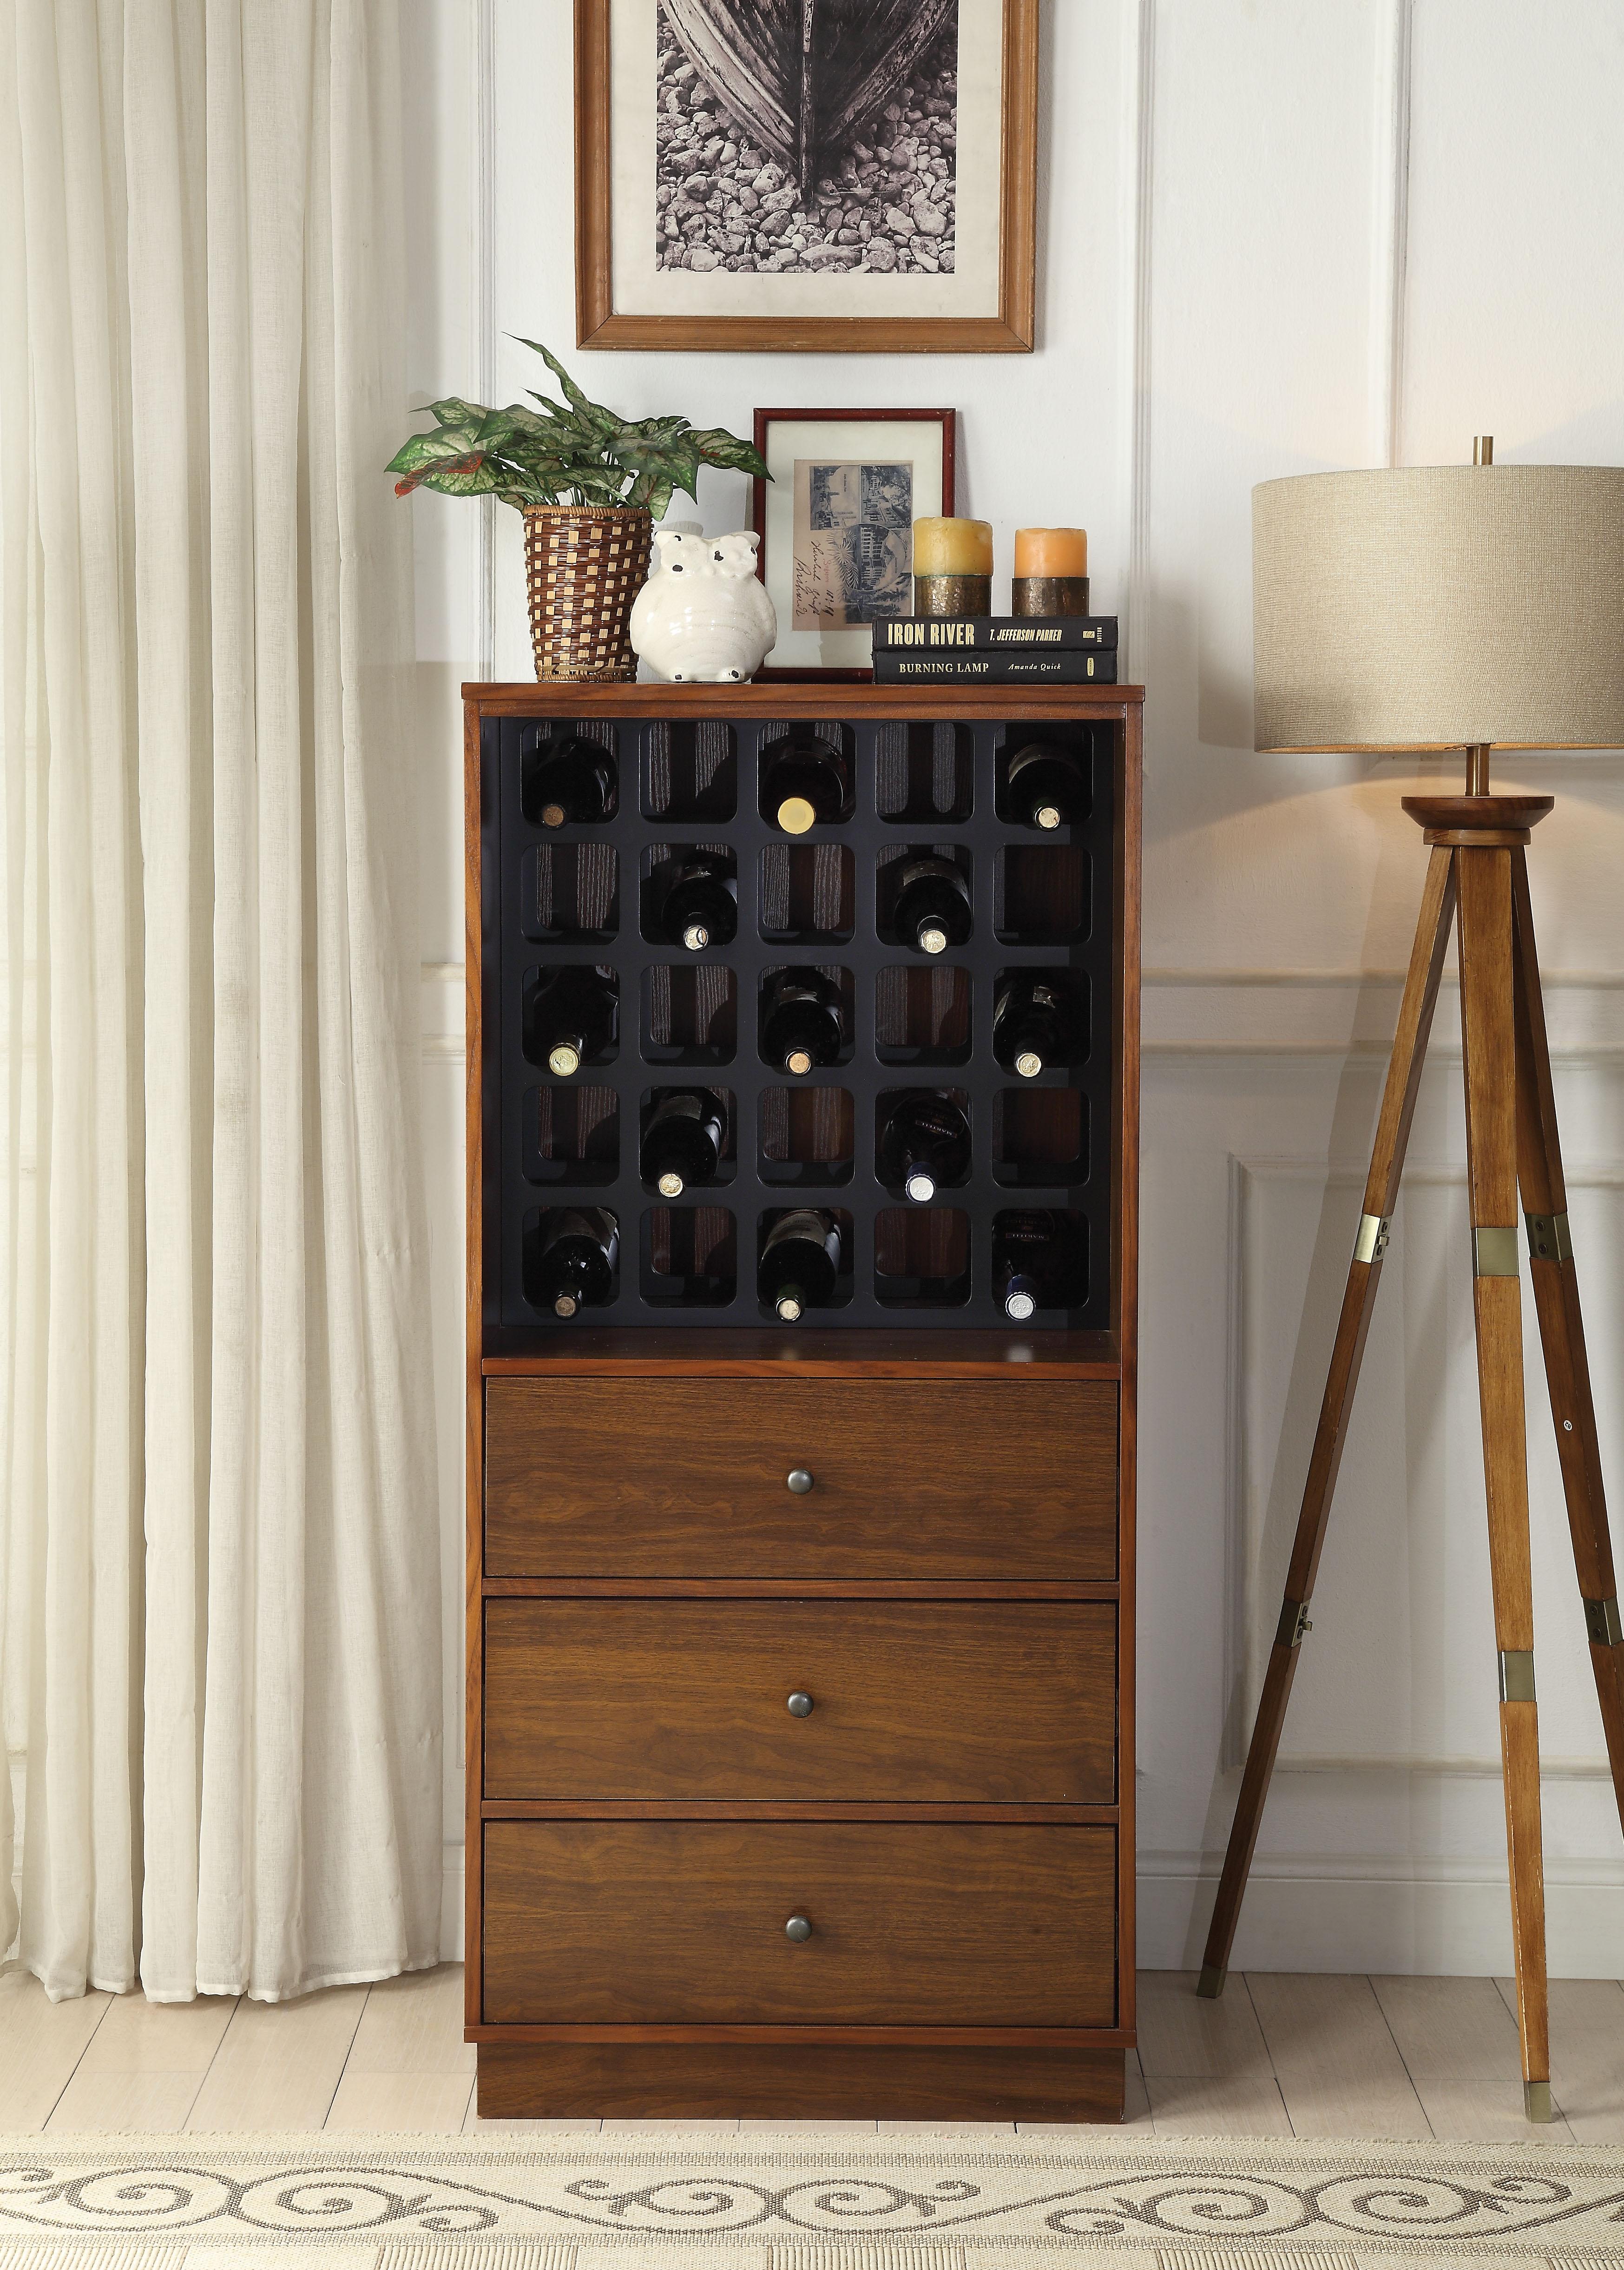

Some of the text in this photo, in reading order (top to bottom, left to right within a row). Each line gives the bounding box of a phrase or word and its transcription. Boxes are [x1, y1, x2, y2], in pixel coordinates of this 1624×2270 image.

[888, 623, 975, 645] IRON RIVER
[989, 629, 1063, 641] T. JEFFERSON PARKER
[899, 663, 989, 673] BURNING LAMP
[1040, 663, 1061, 671] Quick
